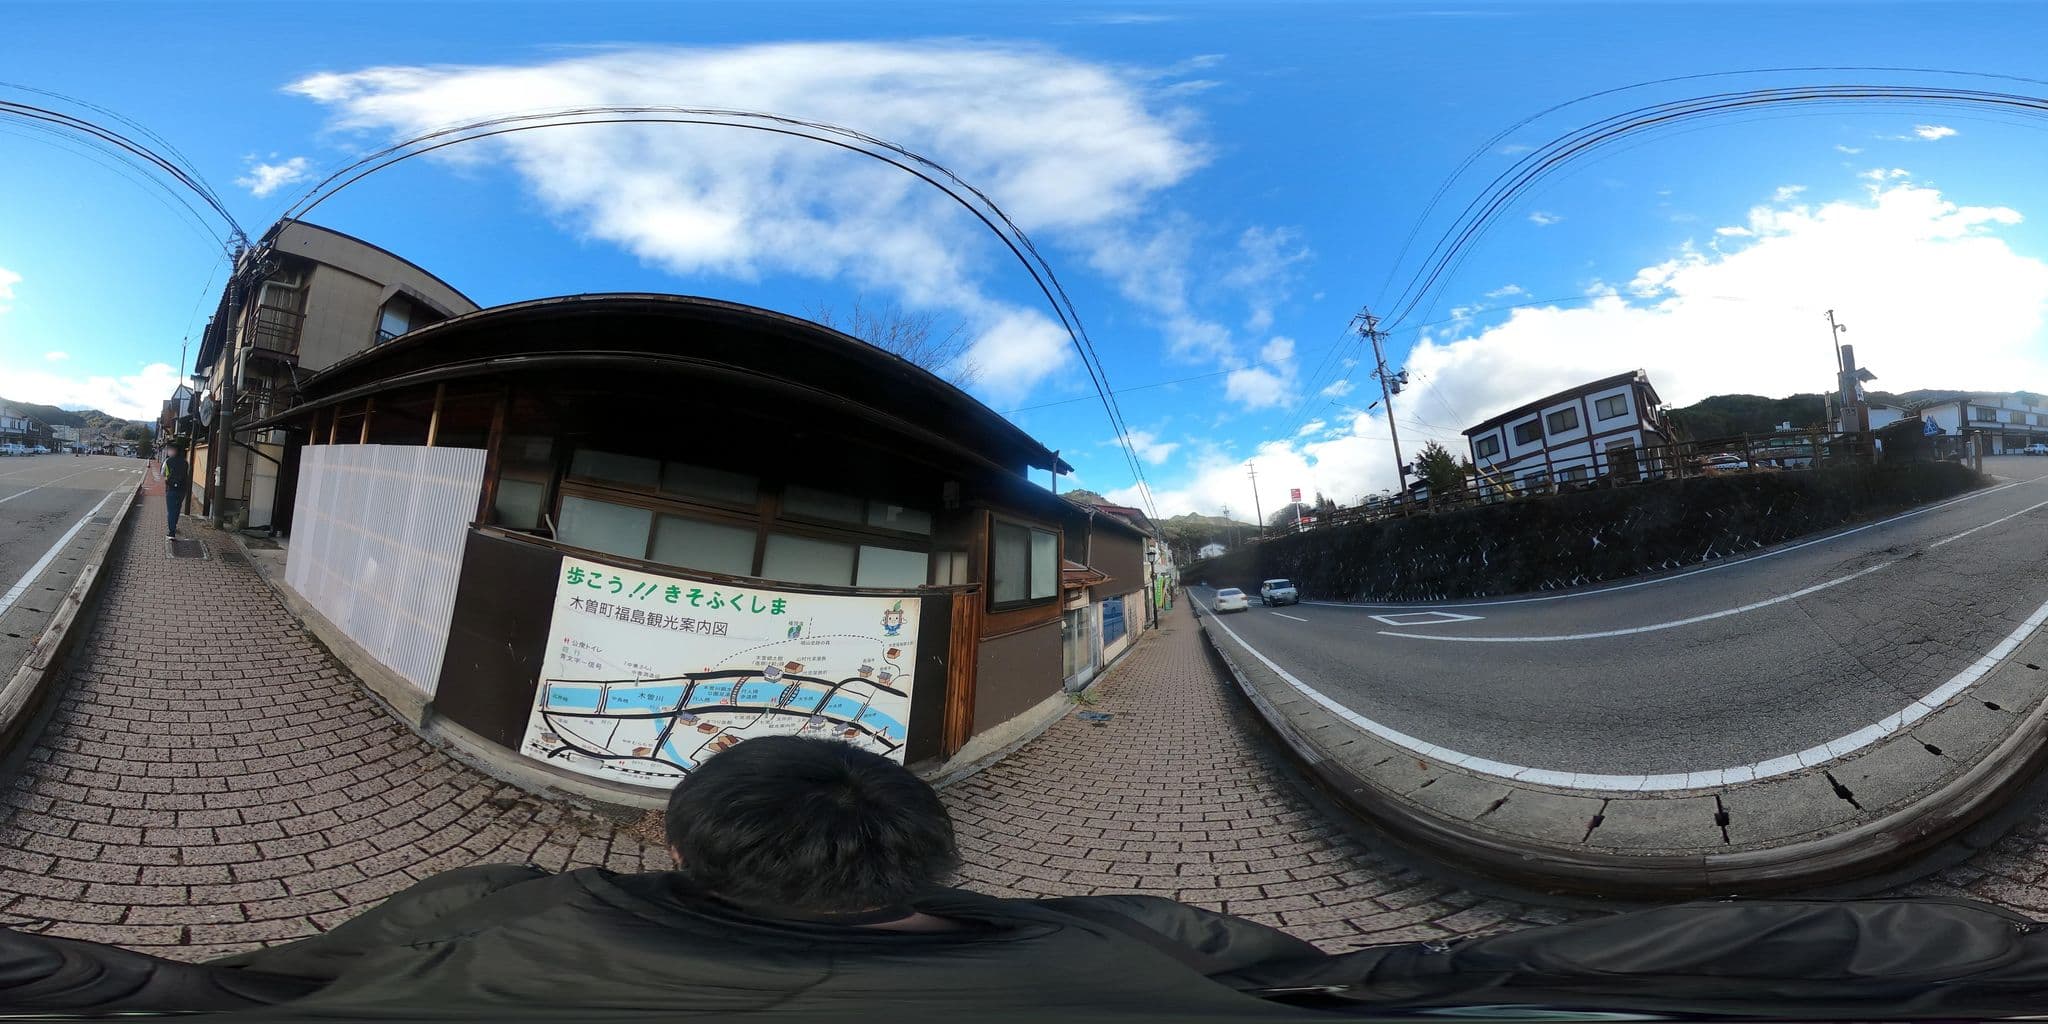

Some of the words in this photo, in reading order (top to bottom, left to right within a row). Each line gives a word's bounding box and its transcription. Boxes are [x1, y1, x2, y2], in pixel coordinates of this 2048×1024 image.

[570, 596, 729, 636] 木曽町福島観光案内図
[572, 640, 602, 653] 公衆トイレ
